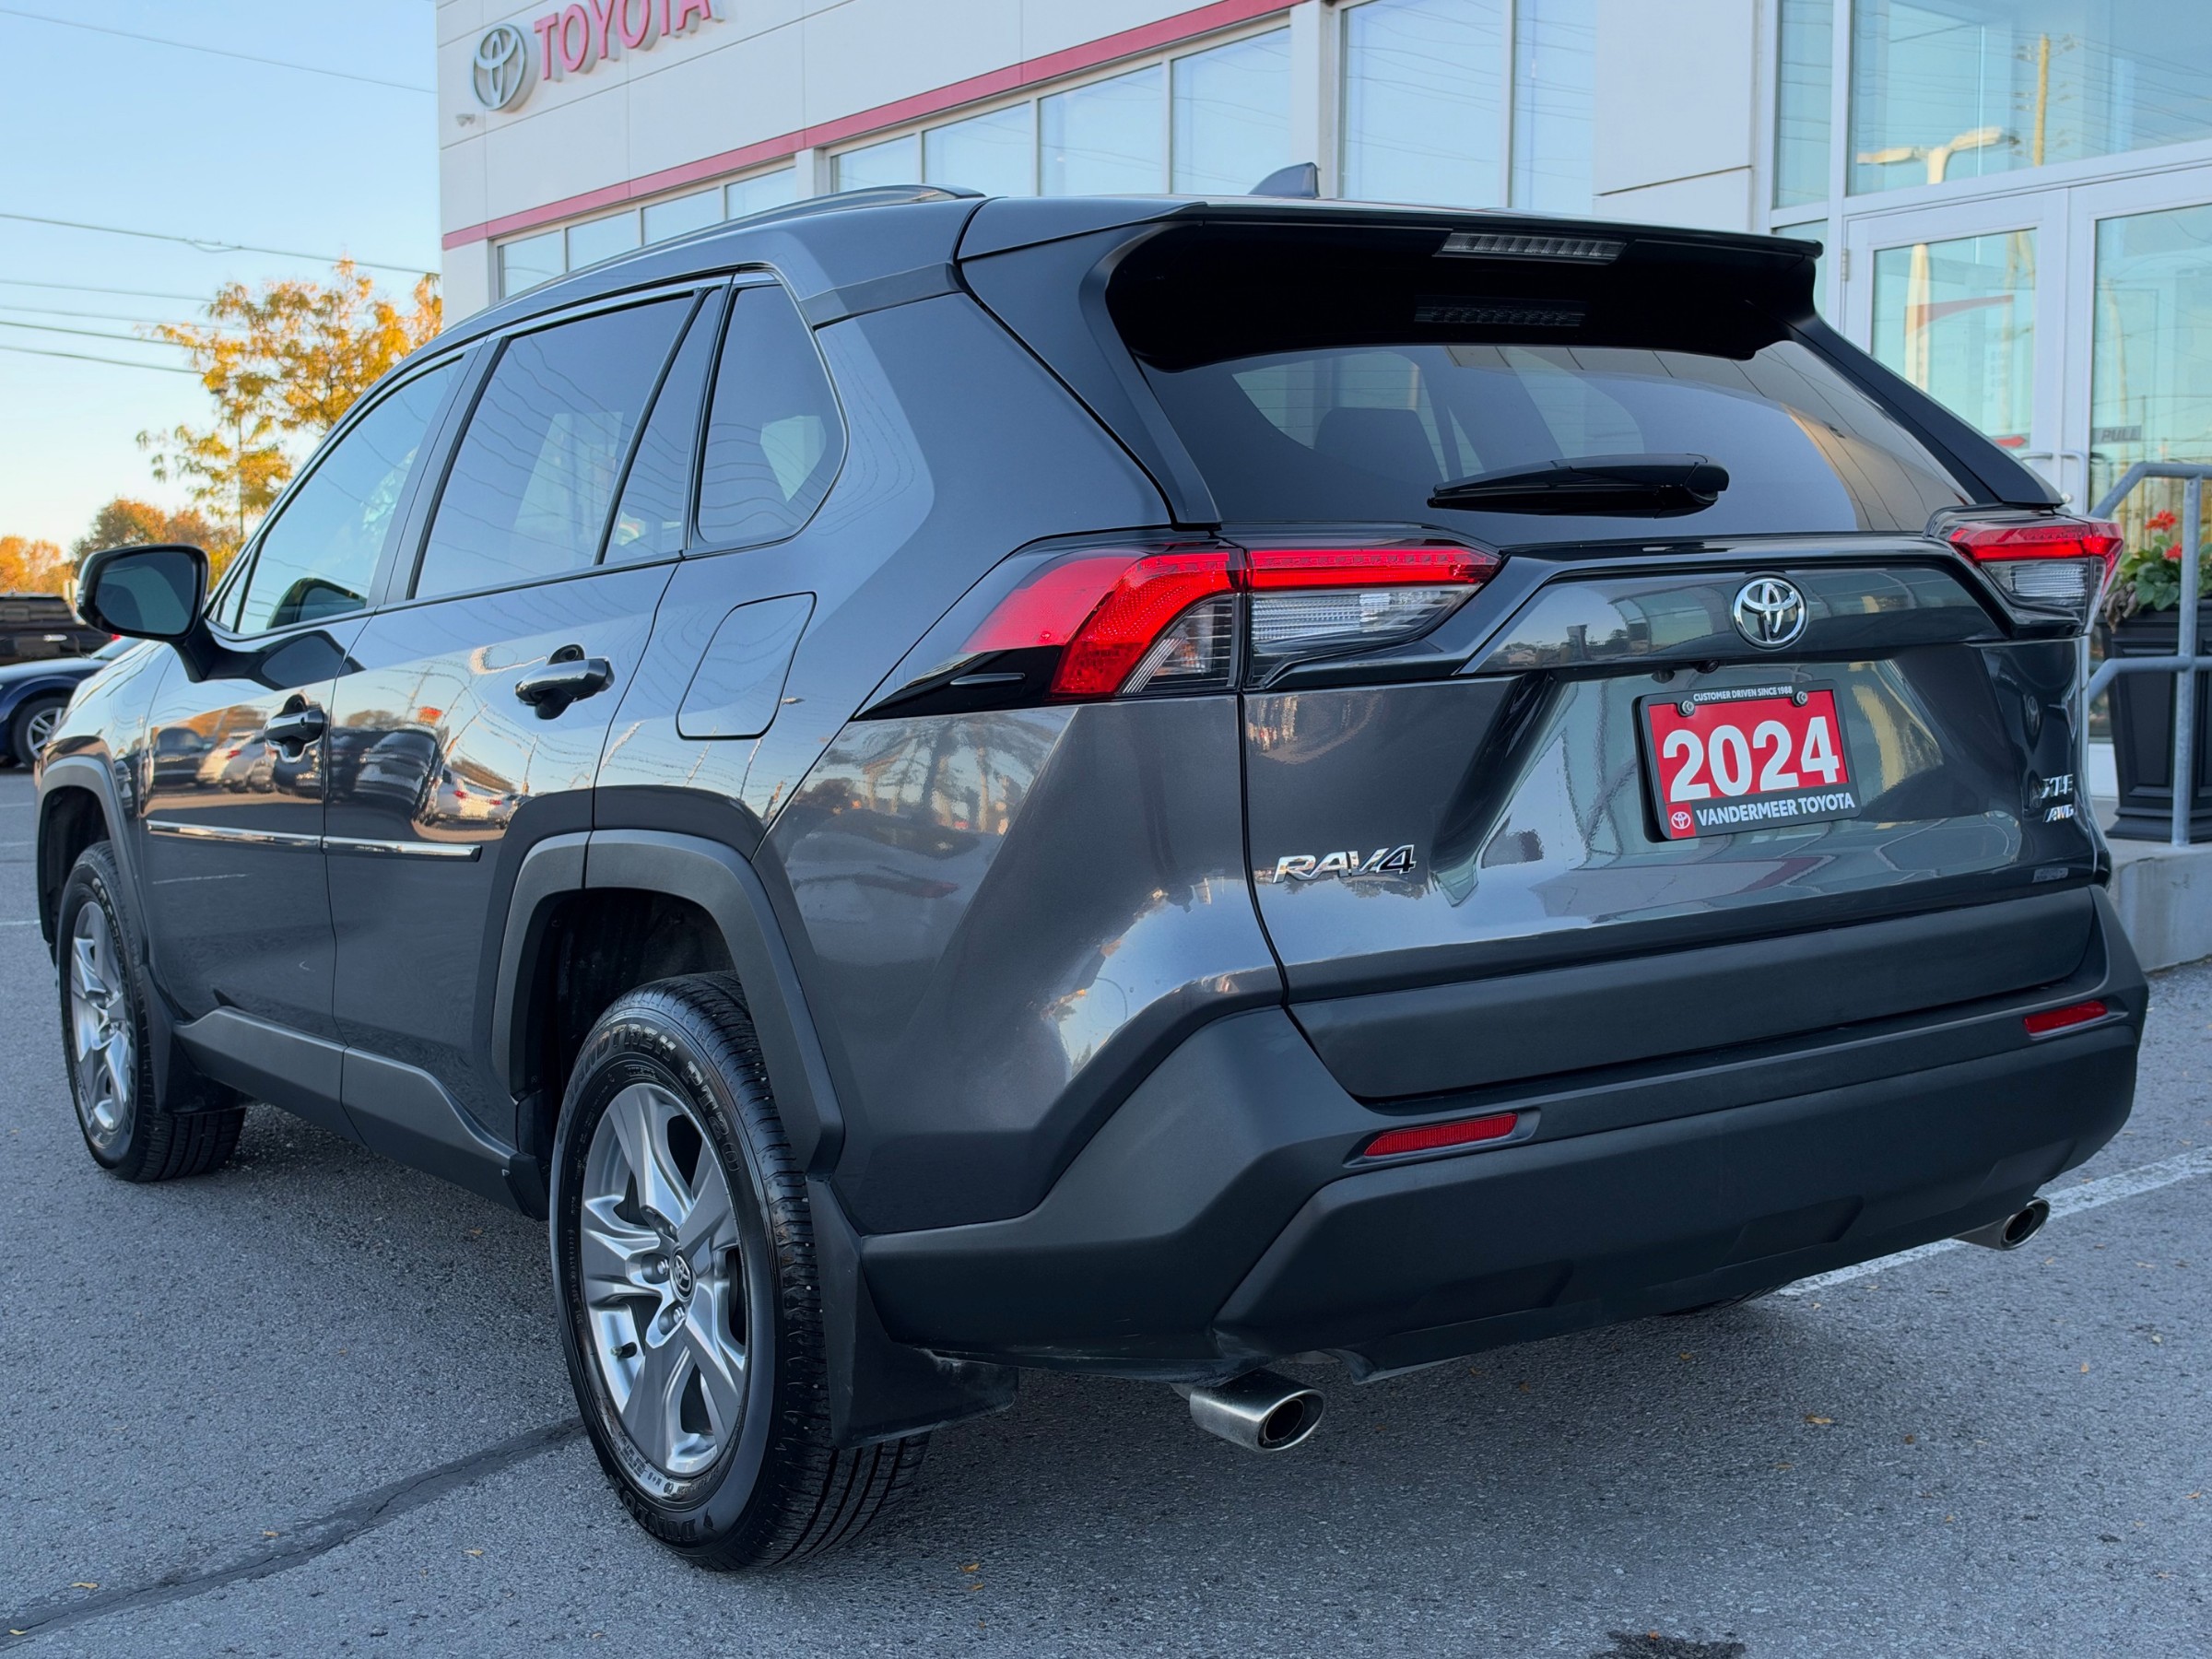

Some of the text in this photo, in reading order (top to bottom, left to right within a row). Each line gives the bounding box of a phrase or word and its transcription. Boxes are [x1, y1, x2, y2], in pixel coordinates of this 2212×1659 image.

[2101, 428, 2140, 441] PULL
[1693, 686, 1794, 702] CUSTOMER DRIVEN SINCE 1988
[1663, 715, 1840, 803] 2024
[1696, 792, 1855, 827] VANDERMEER TOYOTA
[1272, 843, 1418, 884] RAV4
